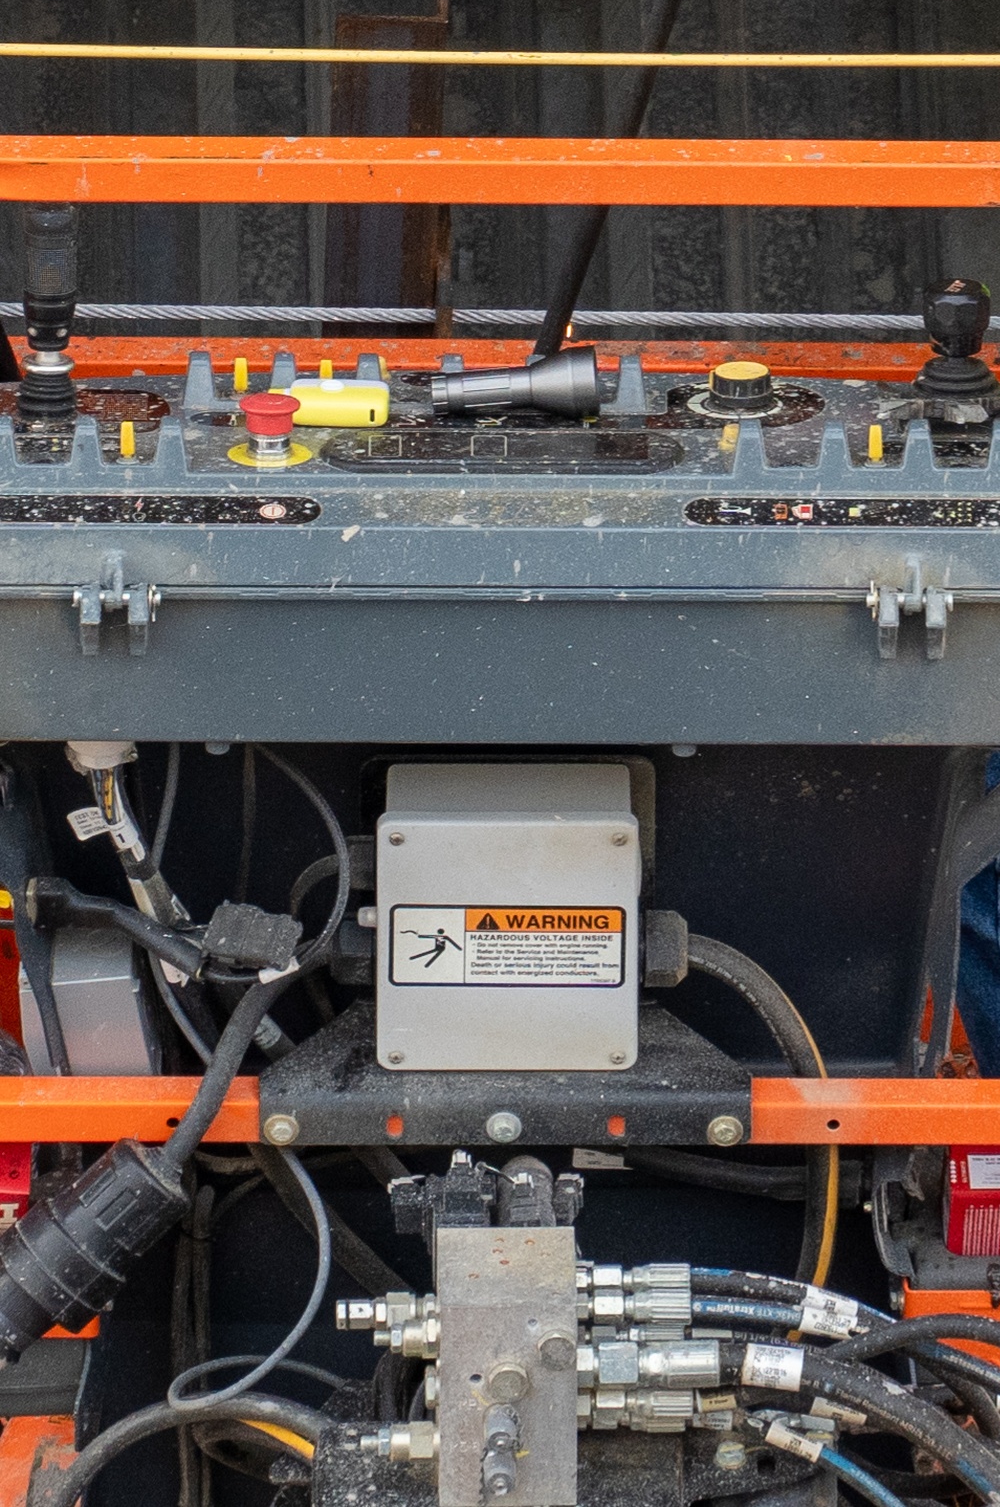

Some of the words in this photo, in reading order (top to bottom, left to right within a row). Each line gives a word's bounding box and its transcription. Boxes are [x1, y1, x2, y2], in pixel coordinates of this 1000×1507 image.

[505, 914, 610, 930] WARNING
[470, 934, 531, 942] HAZARDOUS
[533, 934, 579, 942] VOLTAGE
[581, 934, 614, 942] INSIDE
